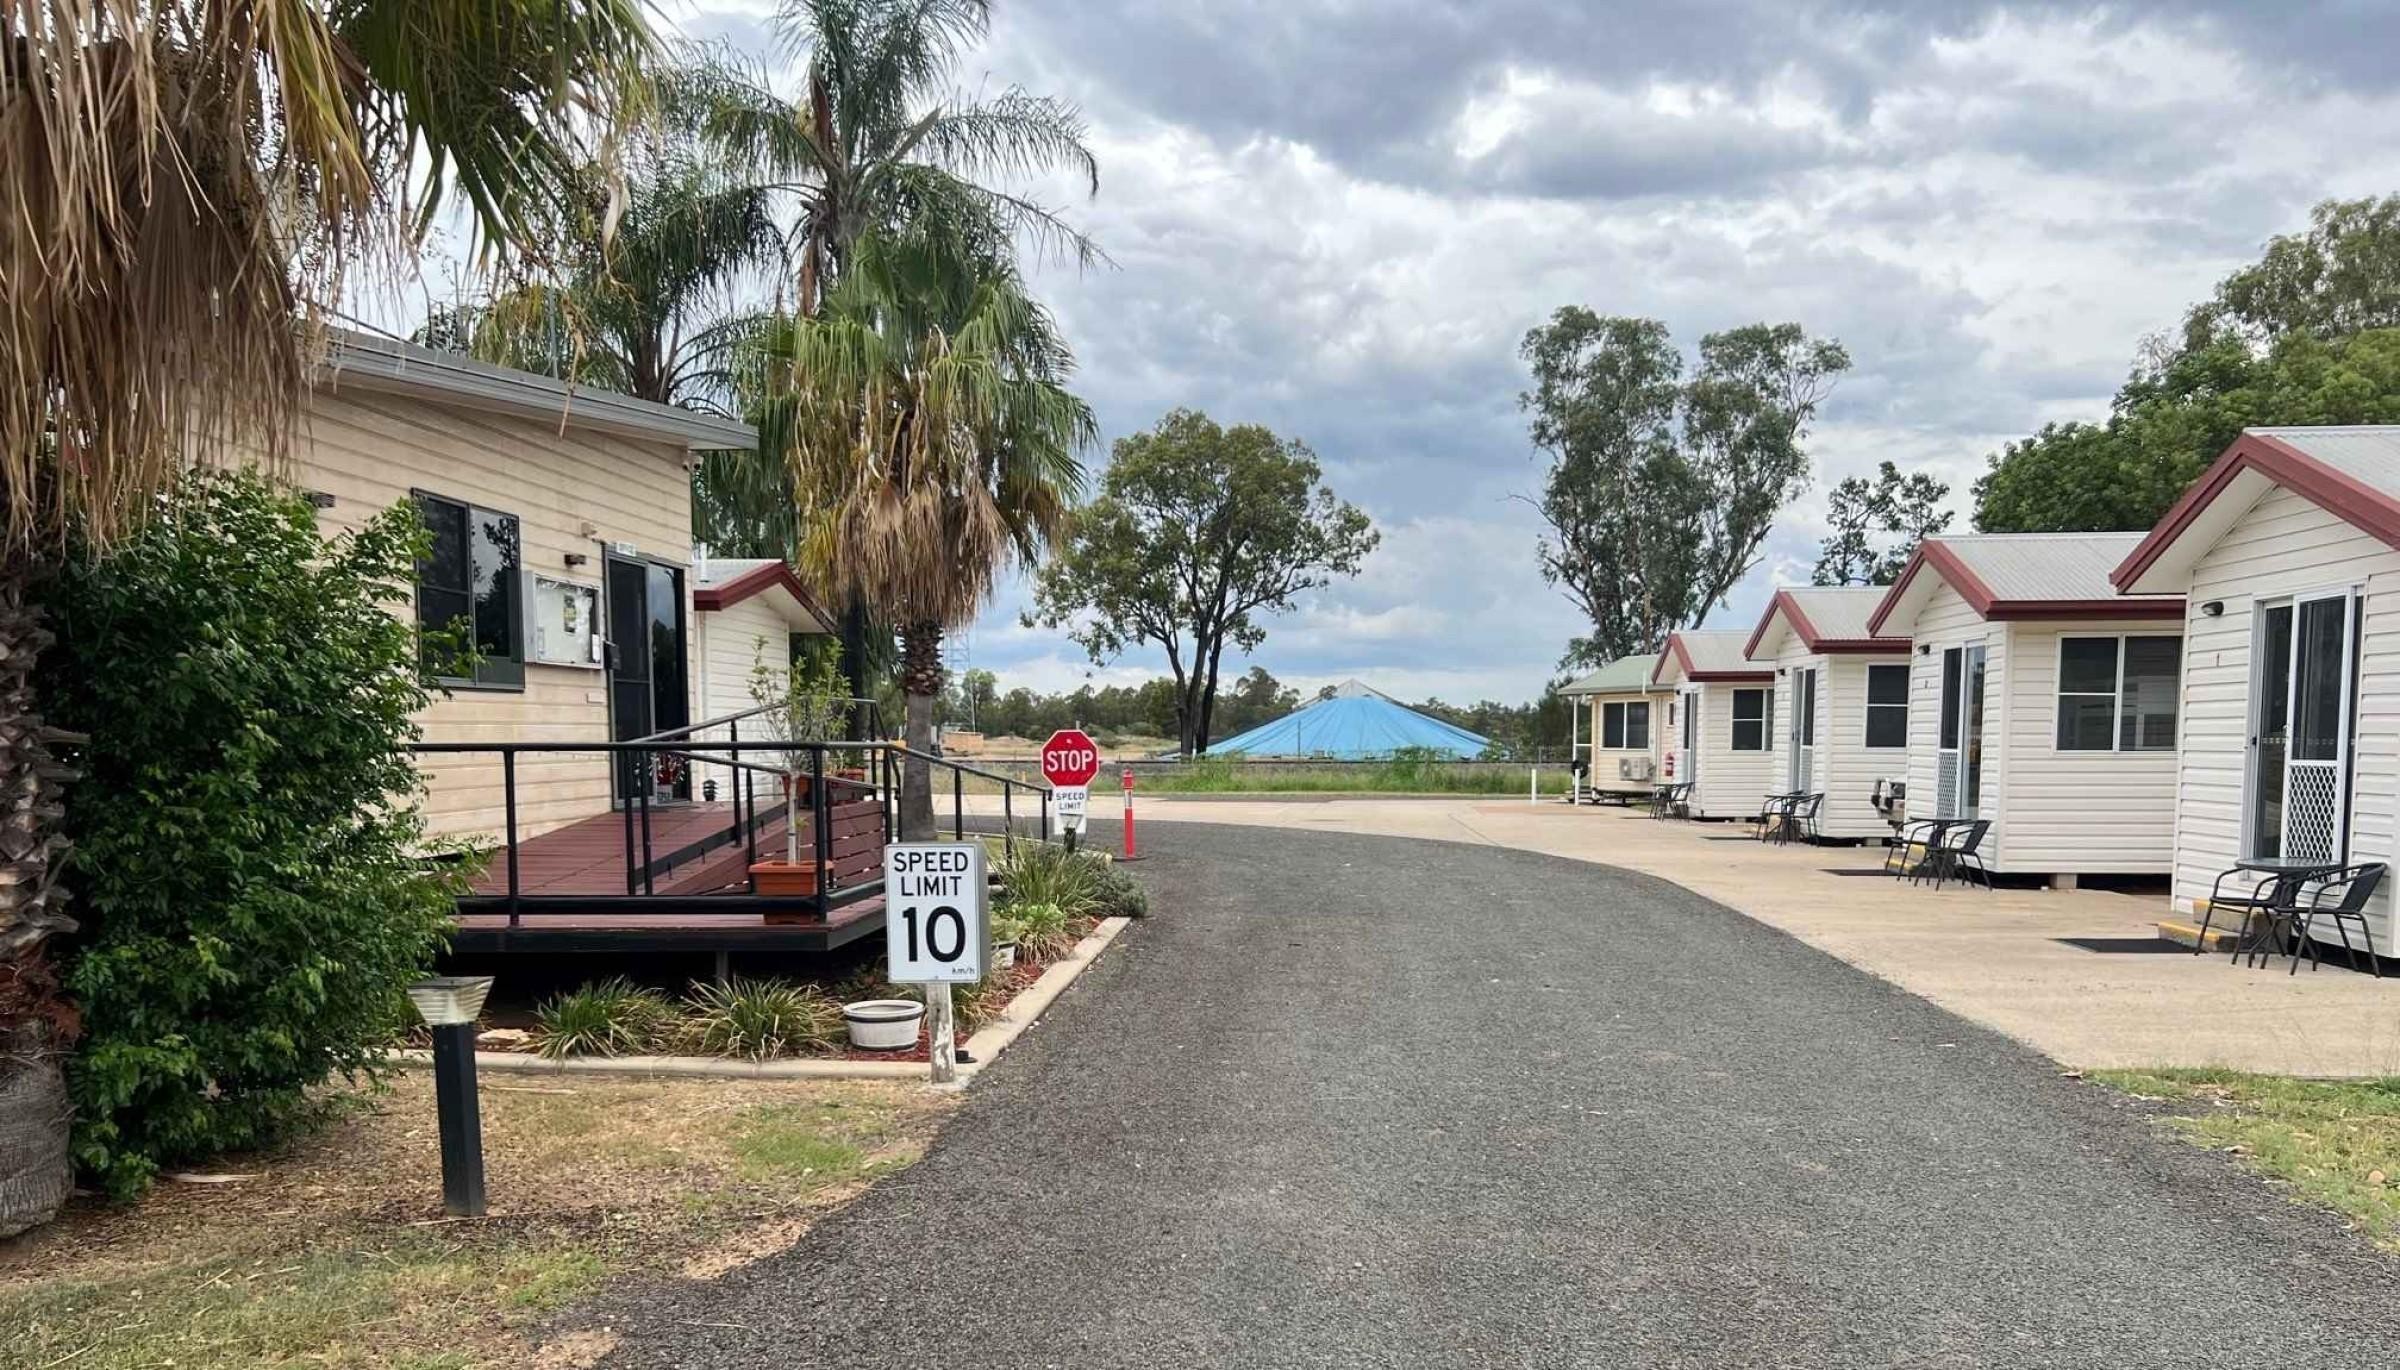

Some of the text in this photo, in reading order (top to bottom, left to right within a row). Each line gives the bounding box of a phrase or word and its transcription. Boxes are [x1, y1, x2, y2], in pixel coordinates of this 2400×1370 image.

[1046, 750, 1094, 772] STOP
[1055, 792, 1085, 801] SPEED
[1059, 802, 1082, 810] LIMIT
[893, 851, 969, 873] SPEED
[900, 875, 962, 897] LIMIT
[902, 905, 966, 963] 10
[951, 967, 975, 975] km/h
